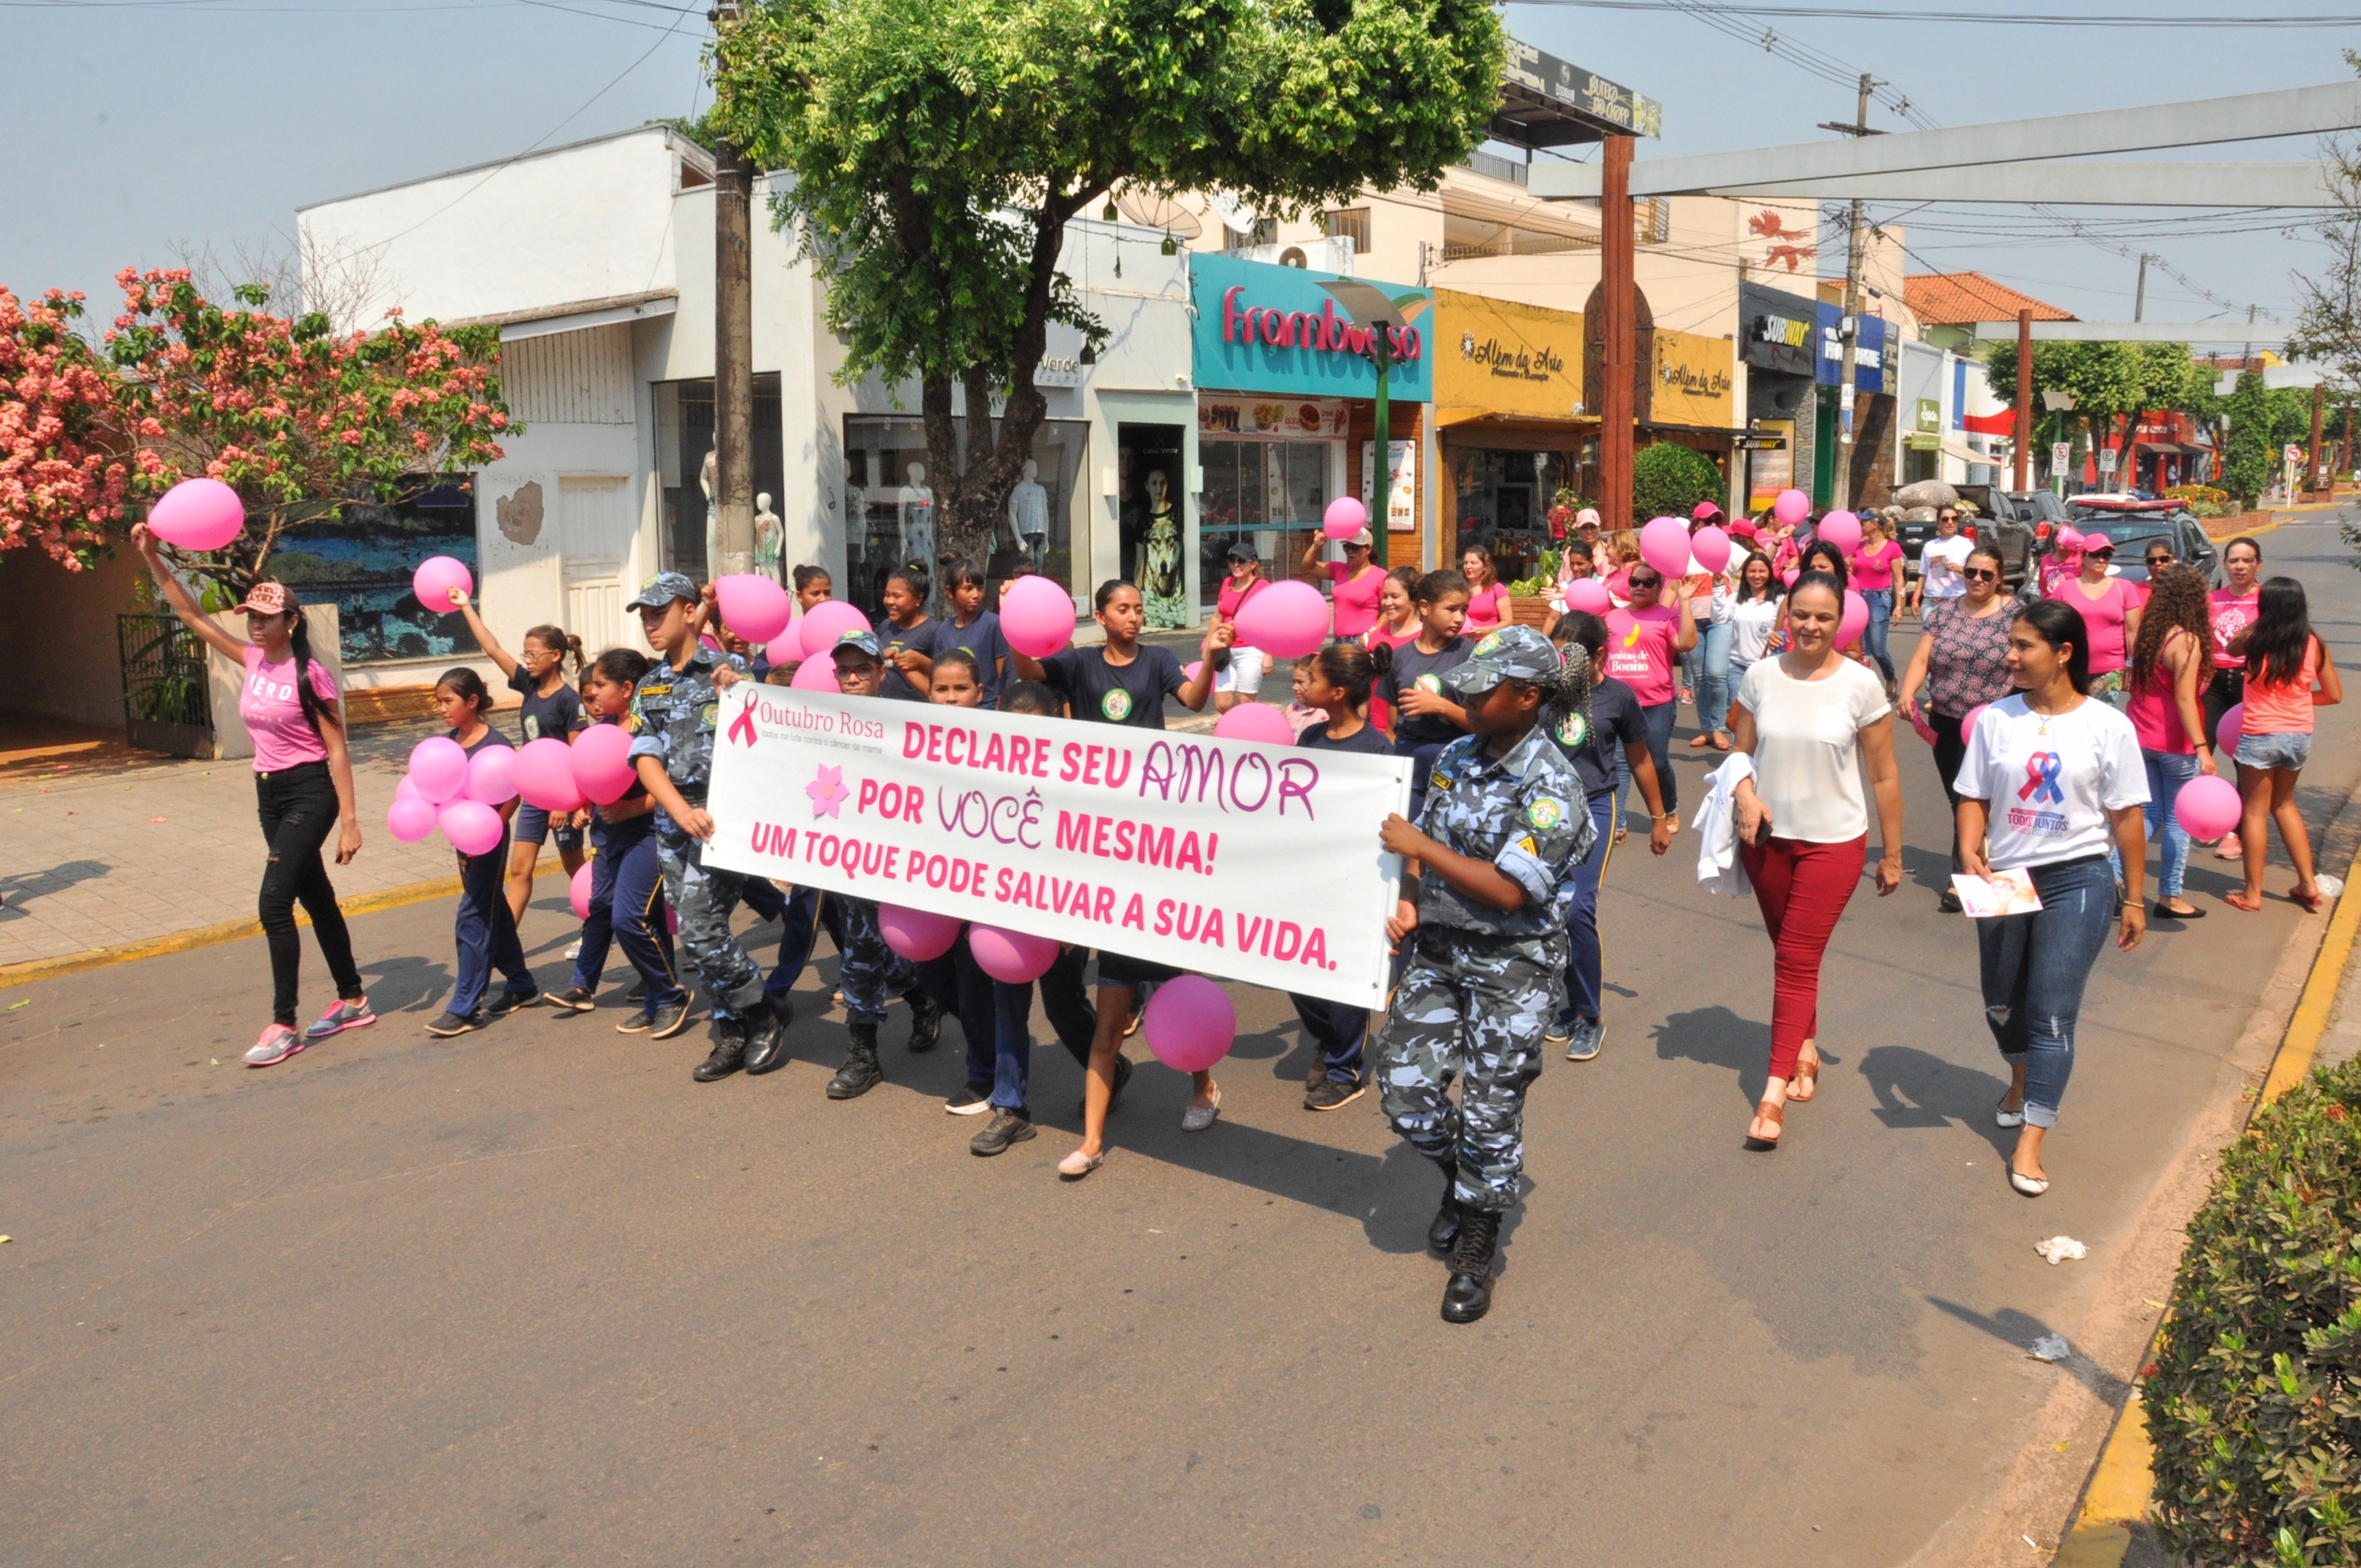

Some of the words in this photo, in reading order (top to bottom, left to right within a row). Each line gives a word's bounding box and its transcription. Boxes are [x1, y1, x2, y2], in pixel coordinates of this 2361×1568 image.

[1592, 96, 1606, 115] DO
[1763, 313, 1810, 348] SUBWAY
[1042, 354, 1079, 374] Verde
[1474, 338, 1515, 366] Além
[1515, 344, 1531, 368] da
[1534, 345, 1564, 372] Arte
[1744, 440, 1780, 449] SUBWAY
[1611, 660, 1649, 672] Bonito
[1638, 650, 1649, 660] de
[761, 701, 833, 732] Outubro
[839, 711, 884, 739] Rosa
[761, 730, 779, 739] todos
[790, 733, 802, 742] luta
[803, 736, 822, 746] contra
[830, 738, 851, 749] câncer
[852, 742, 861, 751] de
[862, 745, 883, 755] mama
[903, 722, 1051, 777] DECLARE
[1059, 742, 1131, 789] SEU
[1139, 740, 1319, 821] AMOR
[858, 779, 924, 824] POR
[938, 785, 1044, 849] VOCÊ
[1056, 810, 1219, 876] MESMA!
[2007, 813, 2033, 828] TODOS
[2033, 816, 2069, 832] JUNTOS
[752, 822, 797, 858] UM
[805, 830, 899, 880] TOQUE
[906, 850, 988, 897] PODE
[995, 867, 1115, 925] SALVAR
[1122, 893, 1145, 931] A
[1154, 899, 1225, 947] SUA
[1236, 912, 1337, 971] VIDA.
